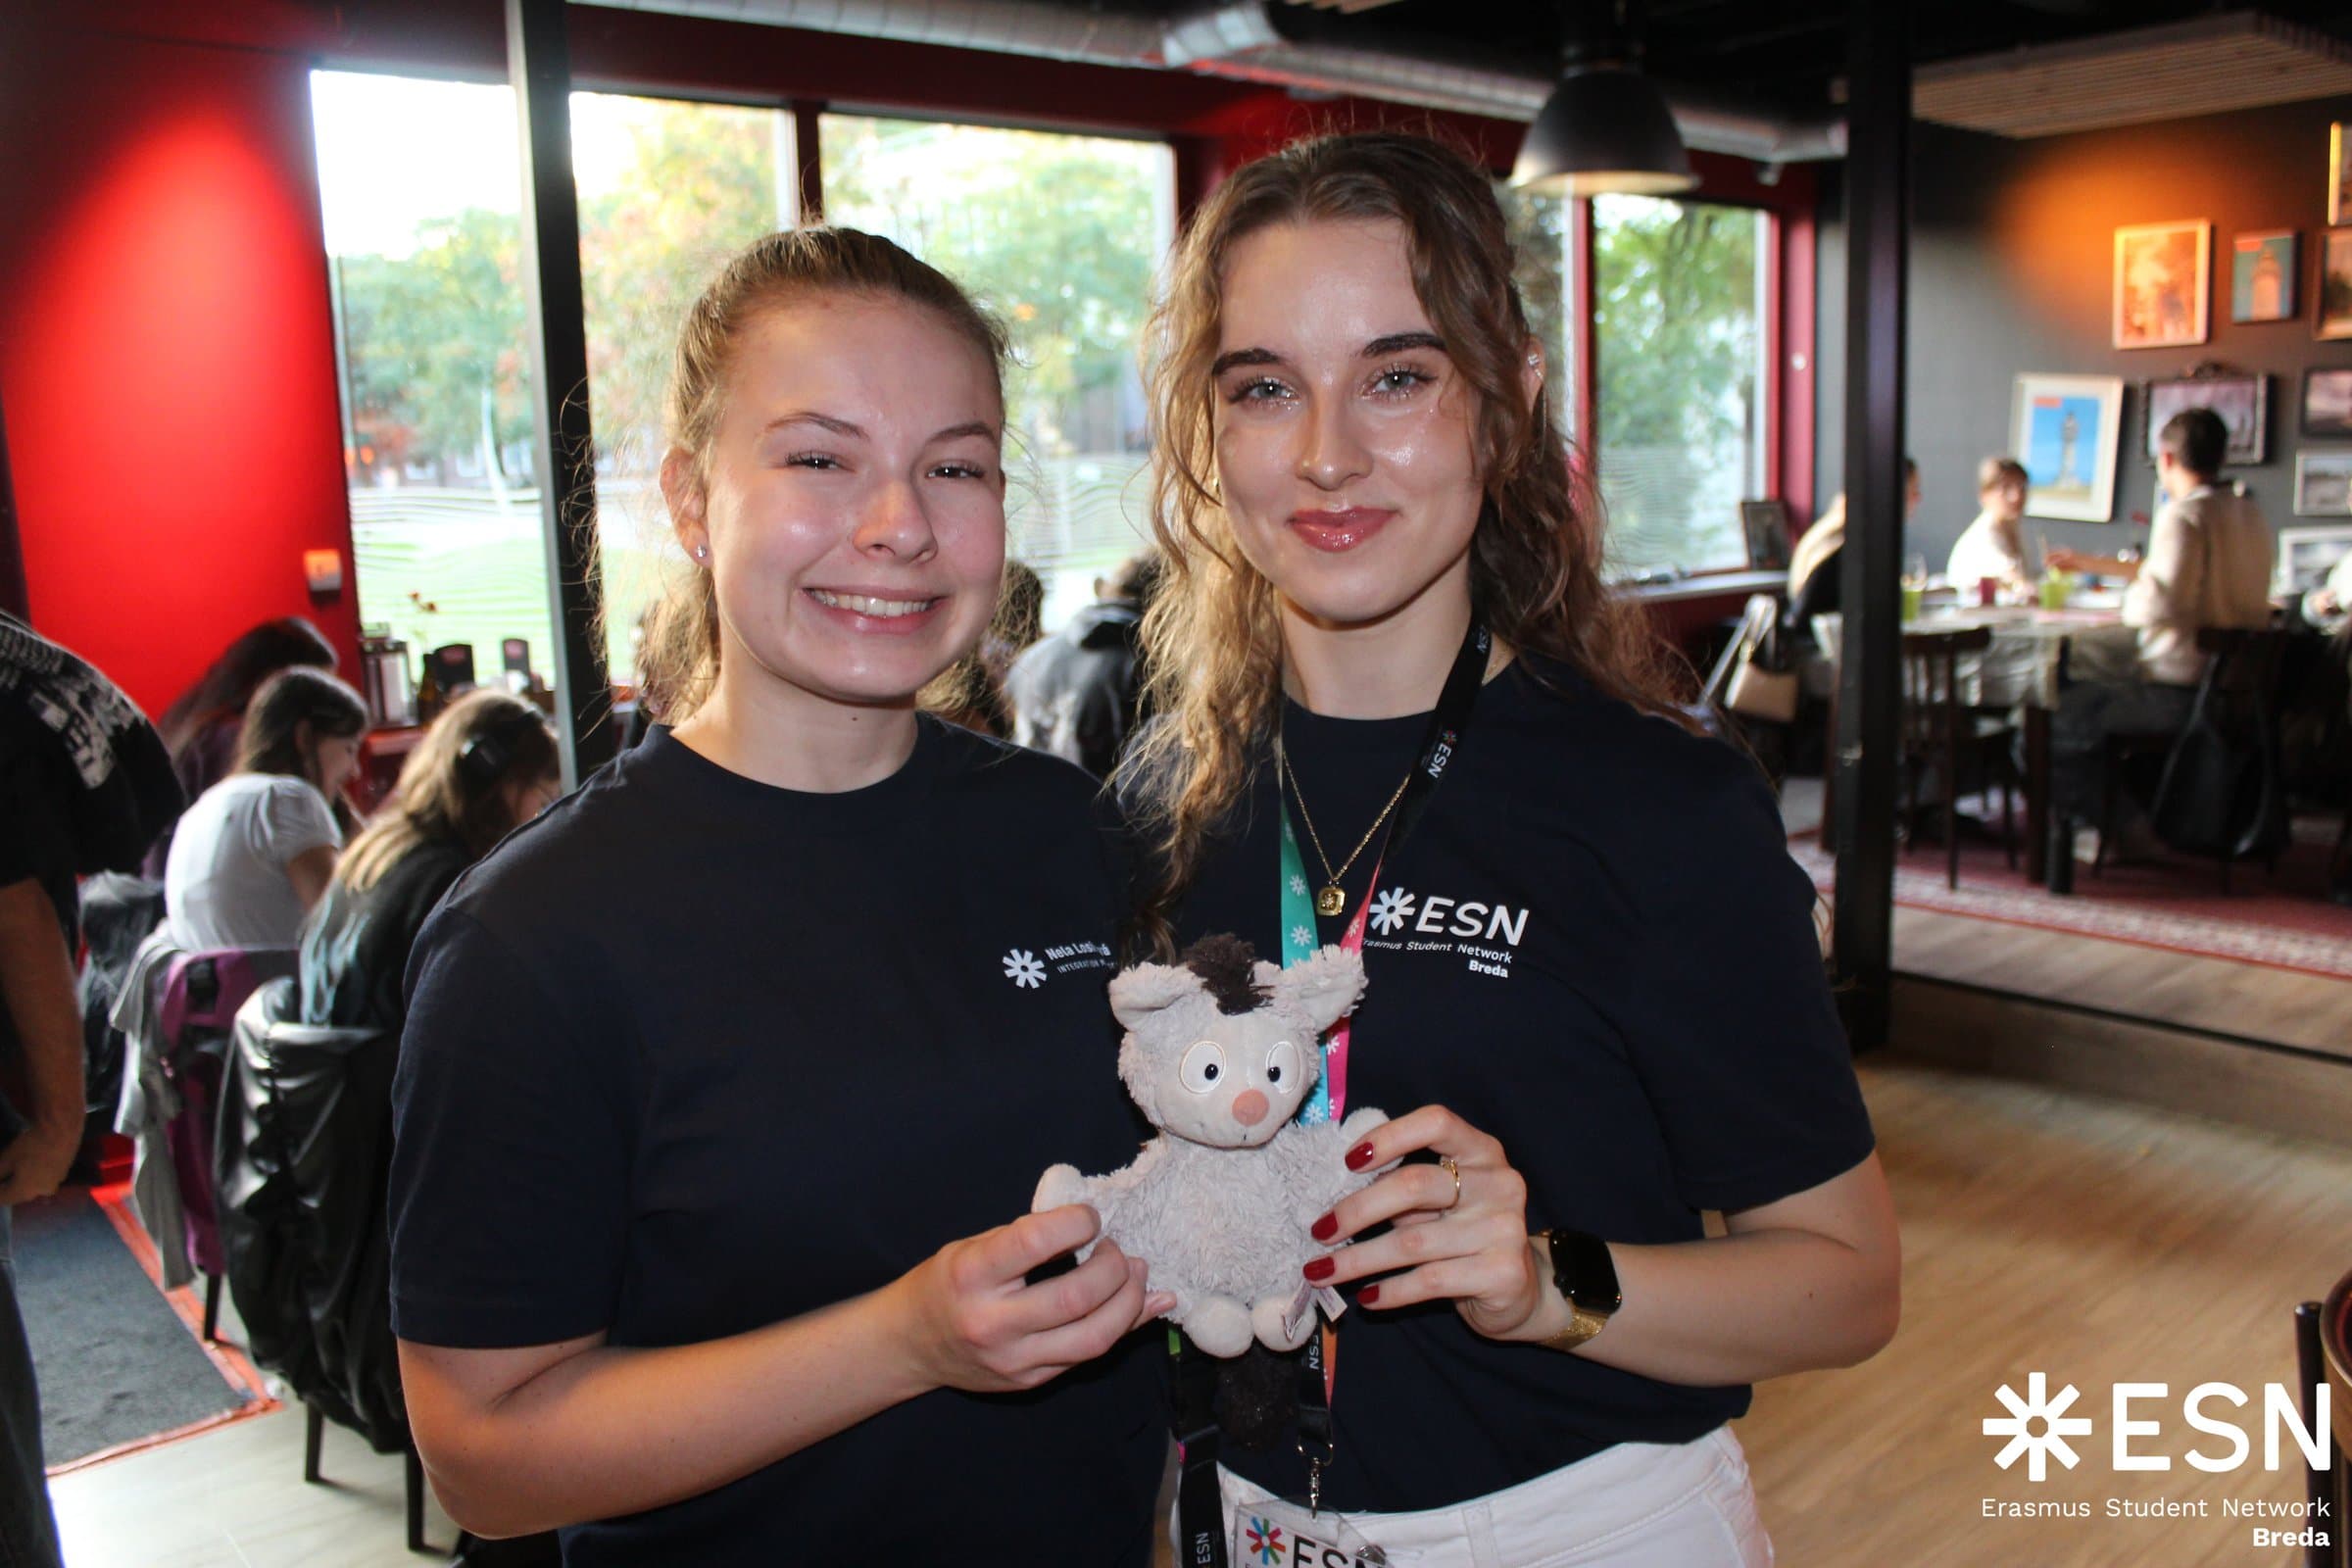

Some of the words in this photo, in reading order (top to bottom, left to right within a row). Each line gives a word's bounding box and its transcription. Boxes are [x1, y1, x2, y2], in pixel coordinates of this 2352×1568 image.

[1428, 743, 1452, 778] ESN
[1415, 895, 1530, 947] ESN
[1363, 938, 1402, 951] rasmus
[1405, 941, 1453, 953] Student
[1457, 944, 1513, 963] Network
[1468, 959, 1508, 978] Breda
[1197, 1532, 1211, 1564] ESN
